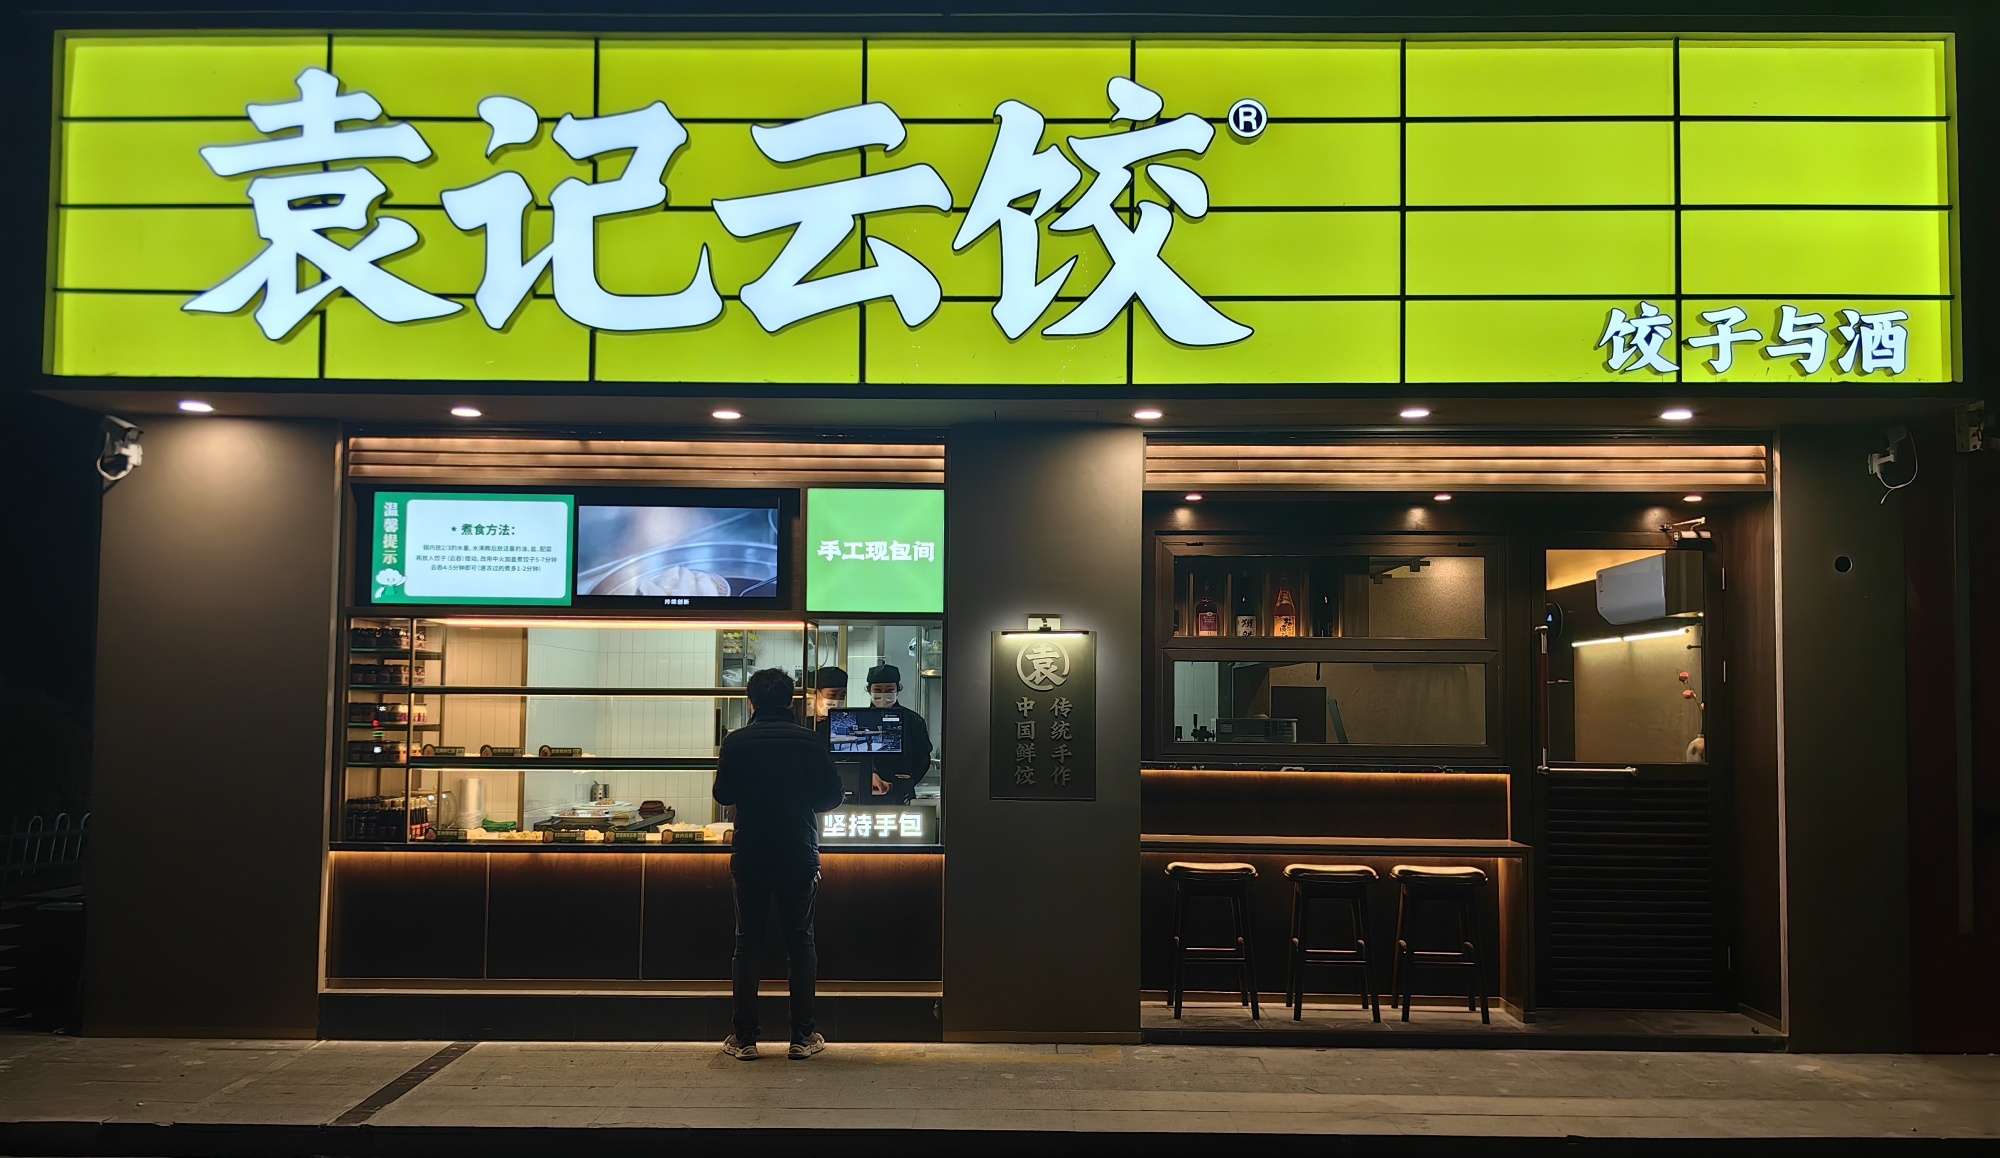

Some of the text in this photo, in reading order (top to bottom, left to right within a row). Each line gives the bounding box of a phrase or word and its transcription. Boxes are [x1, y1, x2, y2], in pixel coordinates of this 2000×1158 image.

[181, 67, 1254, 346] 袁记云饺
[1598, 301, 1909, 375] 饺子与酒
[383, 501, 400, 565] 温馨提示
[816, 539, 935, 562] 手工现包间
[1025, 645, 1068, 686] 袁
[1015, 696, 1038, 785] 中国鲜饺
[1050, 697, 1073, 786] 传统手作
[822, 813, 924, 837] 坚持手包
